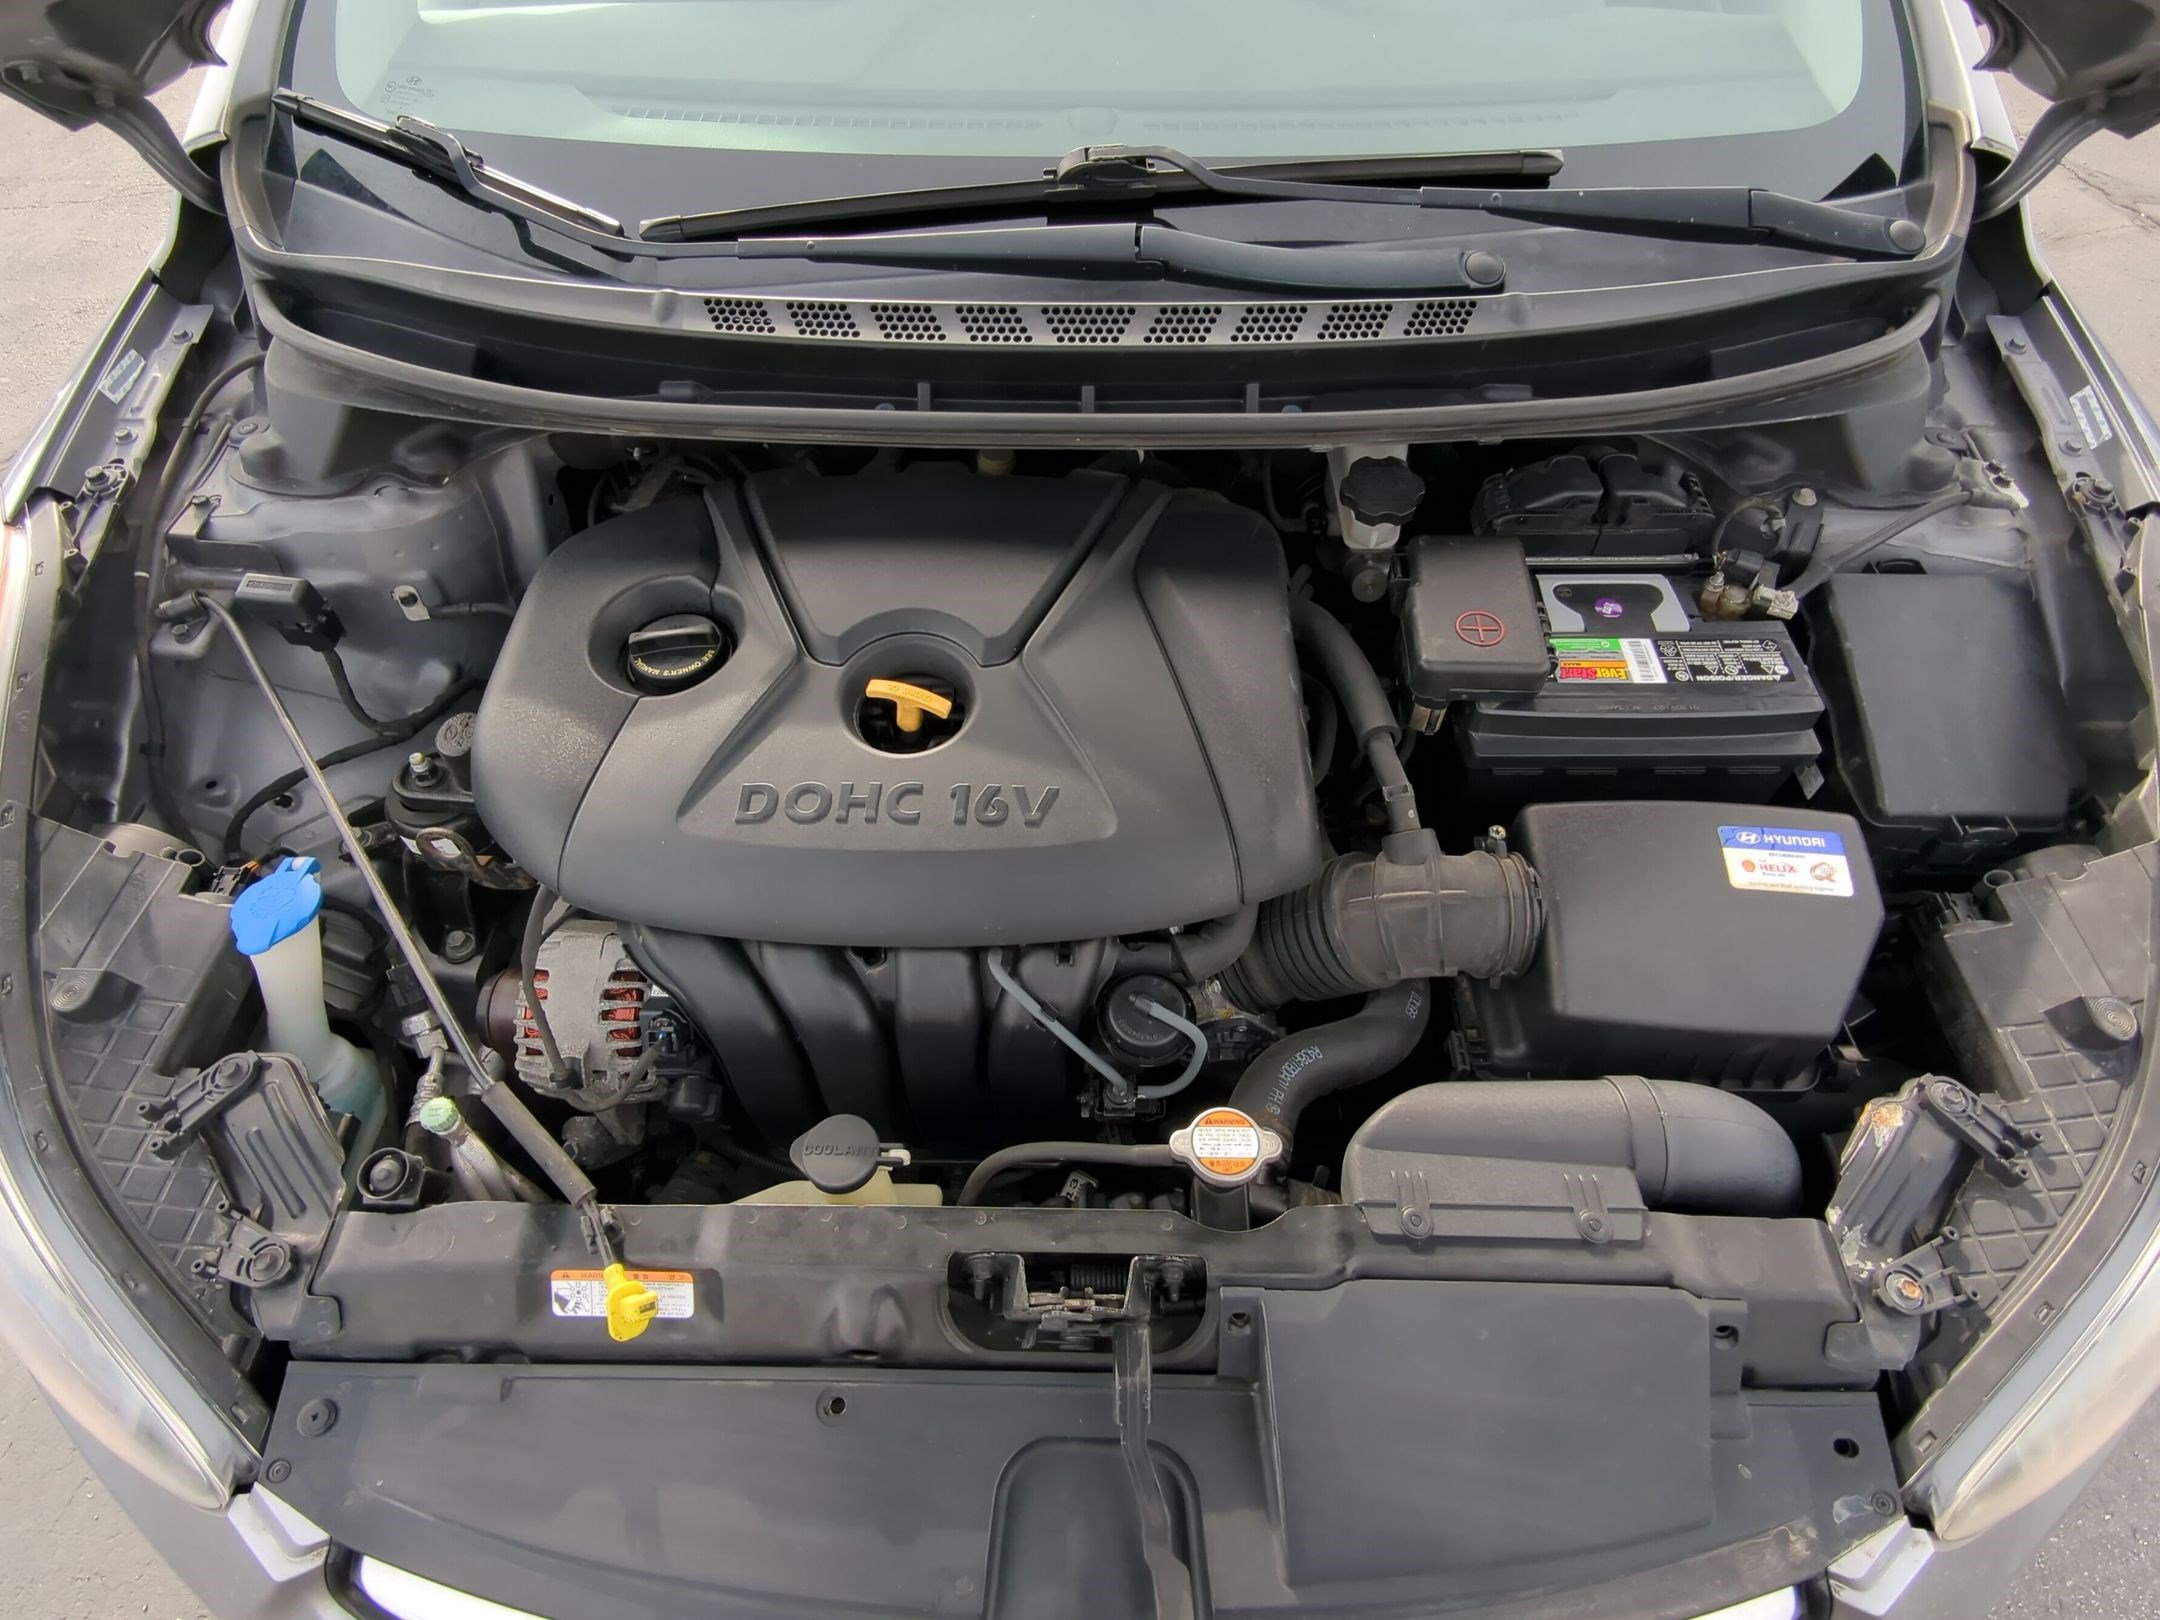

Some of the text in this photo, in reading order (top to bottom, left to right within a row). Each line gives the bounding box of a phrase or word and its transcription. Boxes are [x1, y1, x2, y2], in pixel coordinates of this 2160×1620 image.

[1559, 667, 1628, 680] EverStart
[734, 781, 1060, 828] DOHC 16V
[1763, 834, 1826, 847] HYUNDAI
[1759, 863, 1799, 874] HELIX
[804, 1144, 878, 1156] COOLANT
